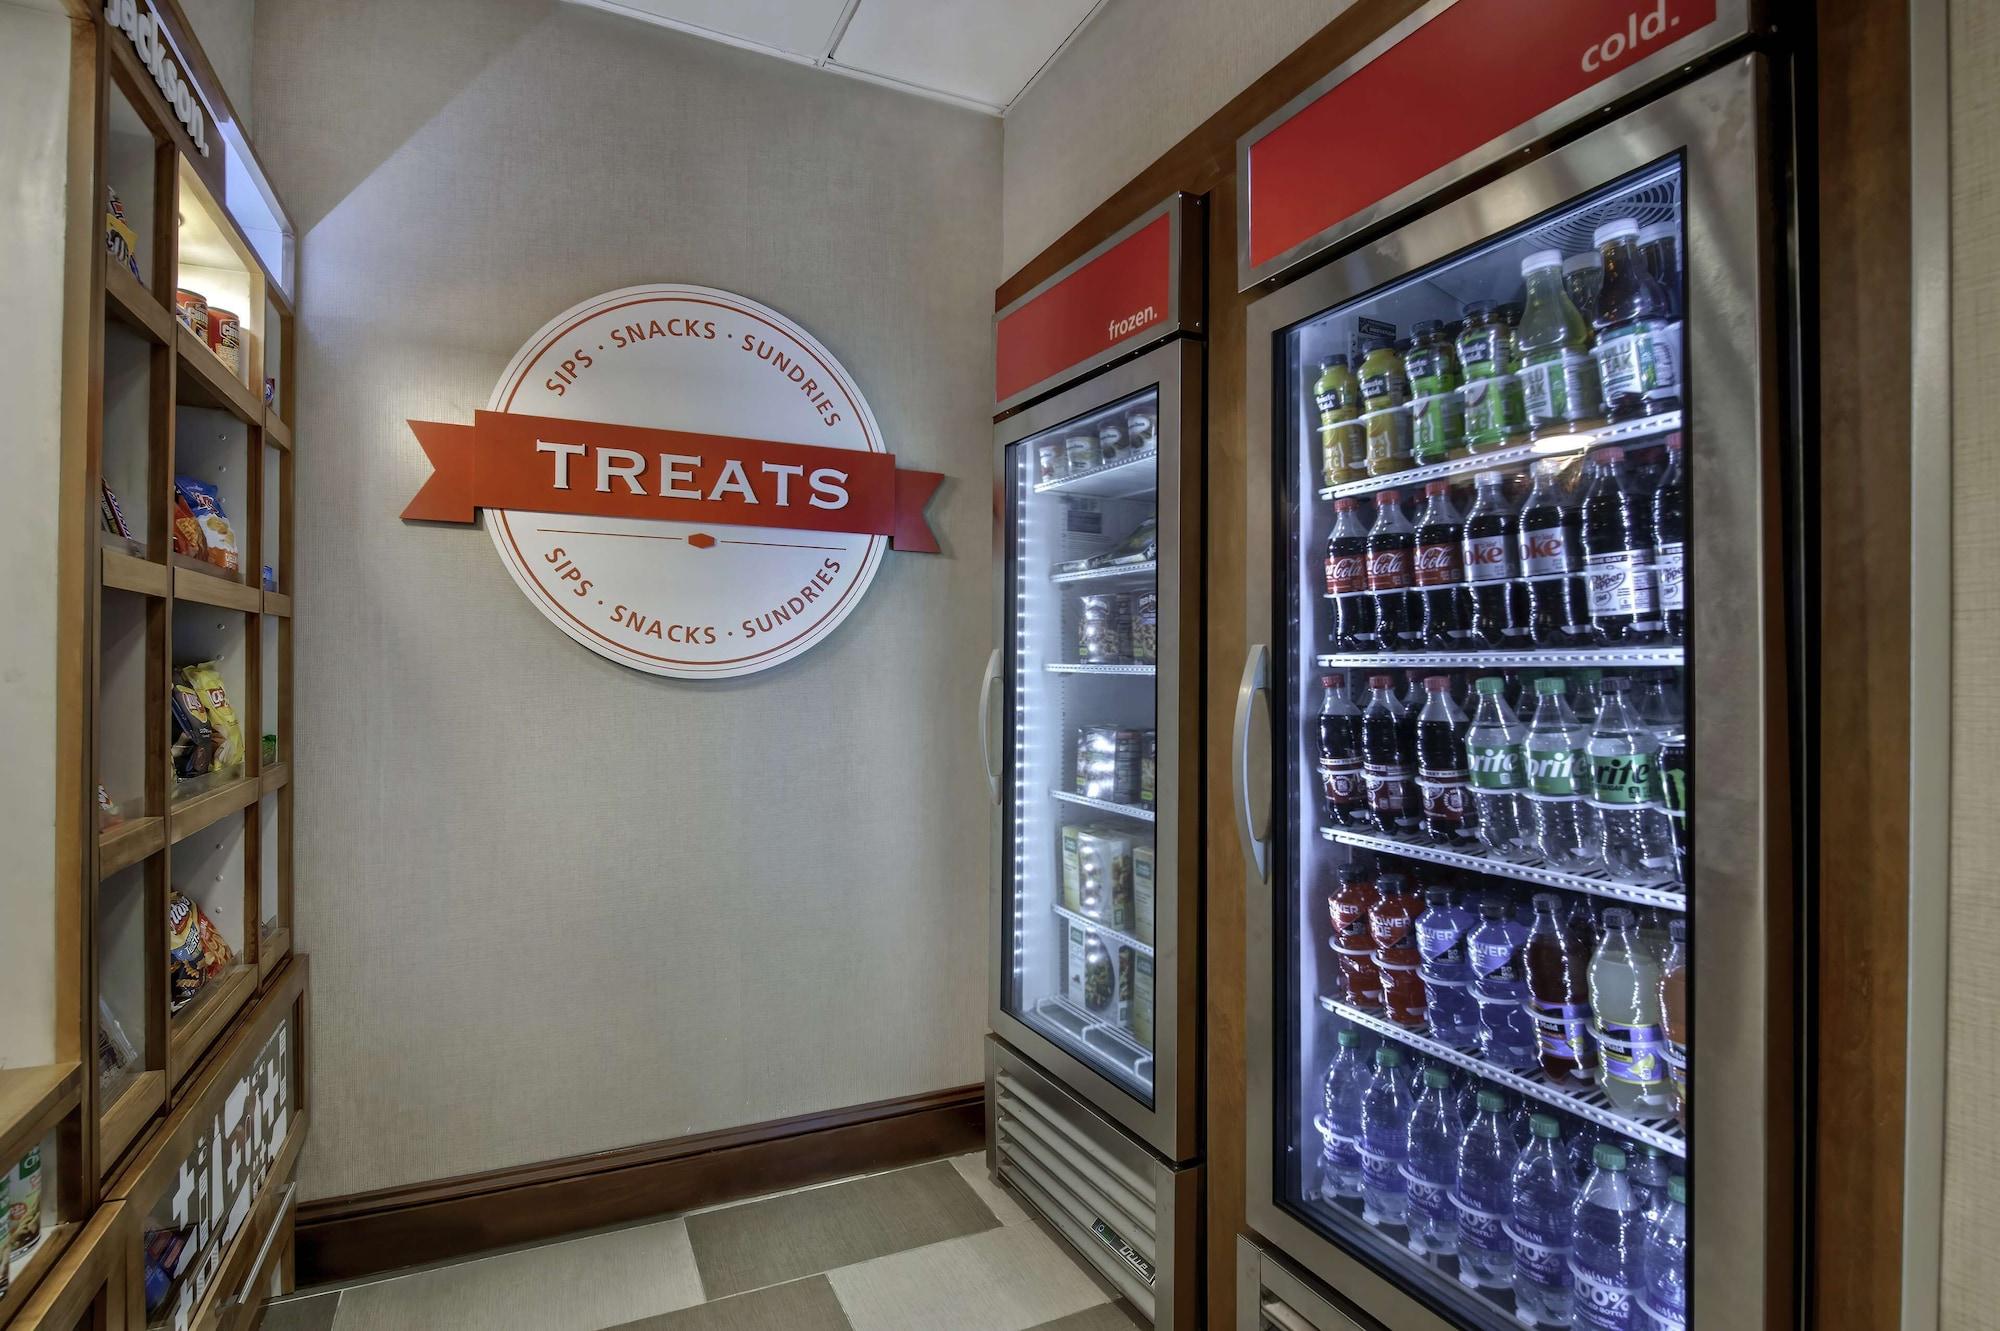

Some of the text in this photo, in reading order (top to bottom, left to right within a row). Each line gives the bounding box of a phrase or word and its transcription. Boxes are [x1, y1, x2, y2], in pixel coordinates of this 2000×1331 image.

[1581, 0, 1679, 73] cold.
[1108, 305, 1158, 341] frozen.
[545, 318, 842, 429] SIPS SNACKS SUNDRIES
[536, 438, 850, 511] TREATS
[544, 546, 842, 645] SIPS SNACKS SUNDRIES
